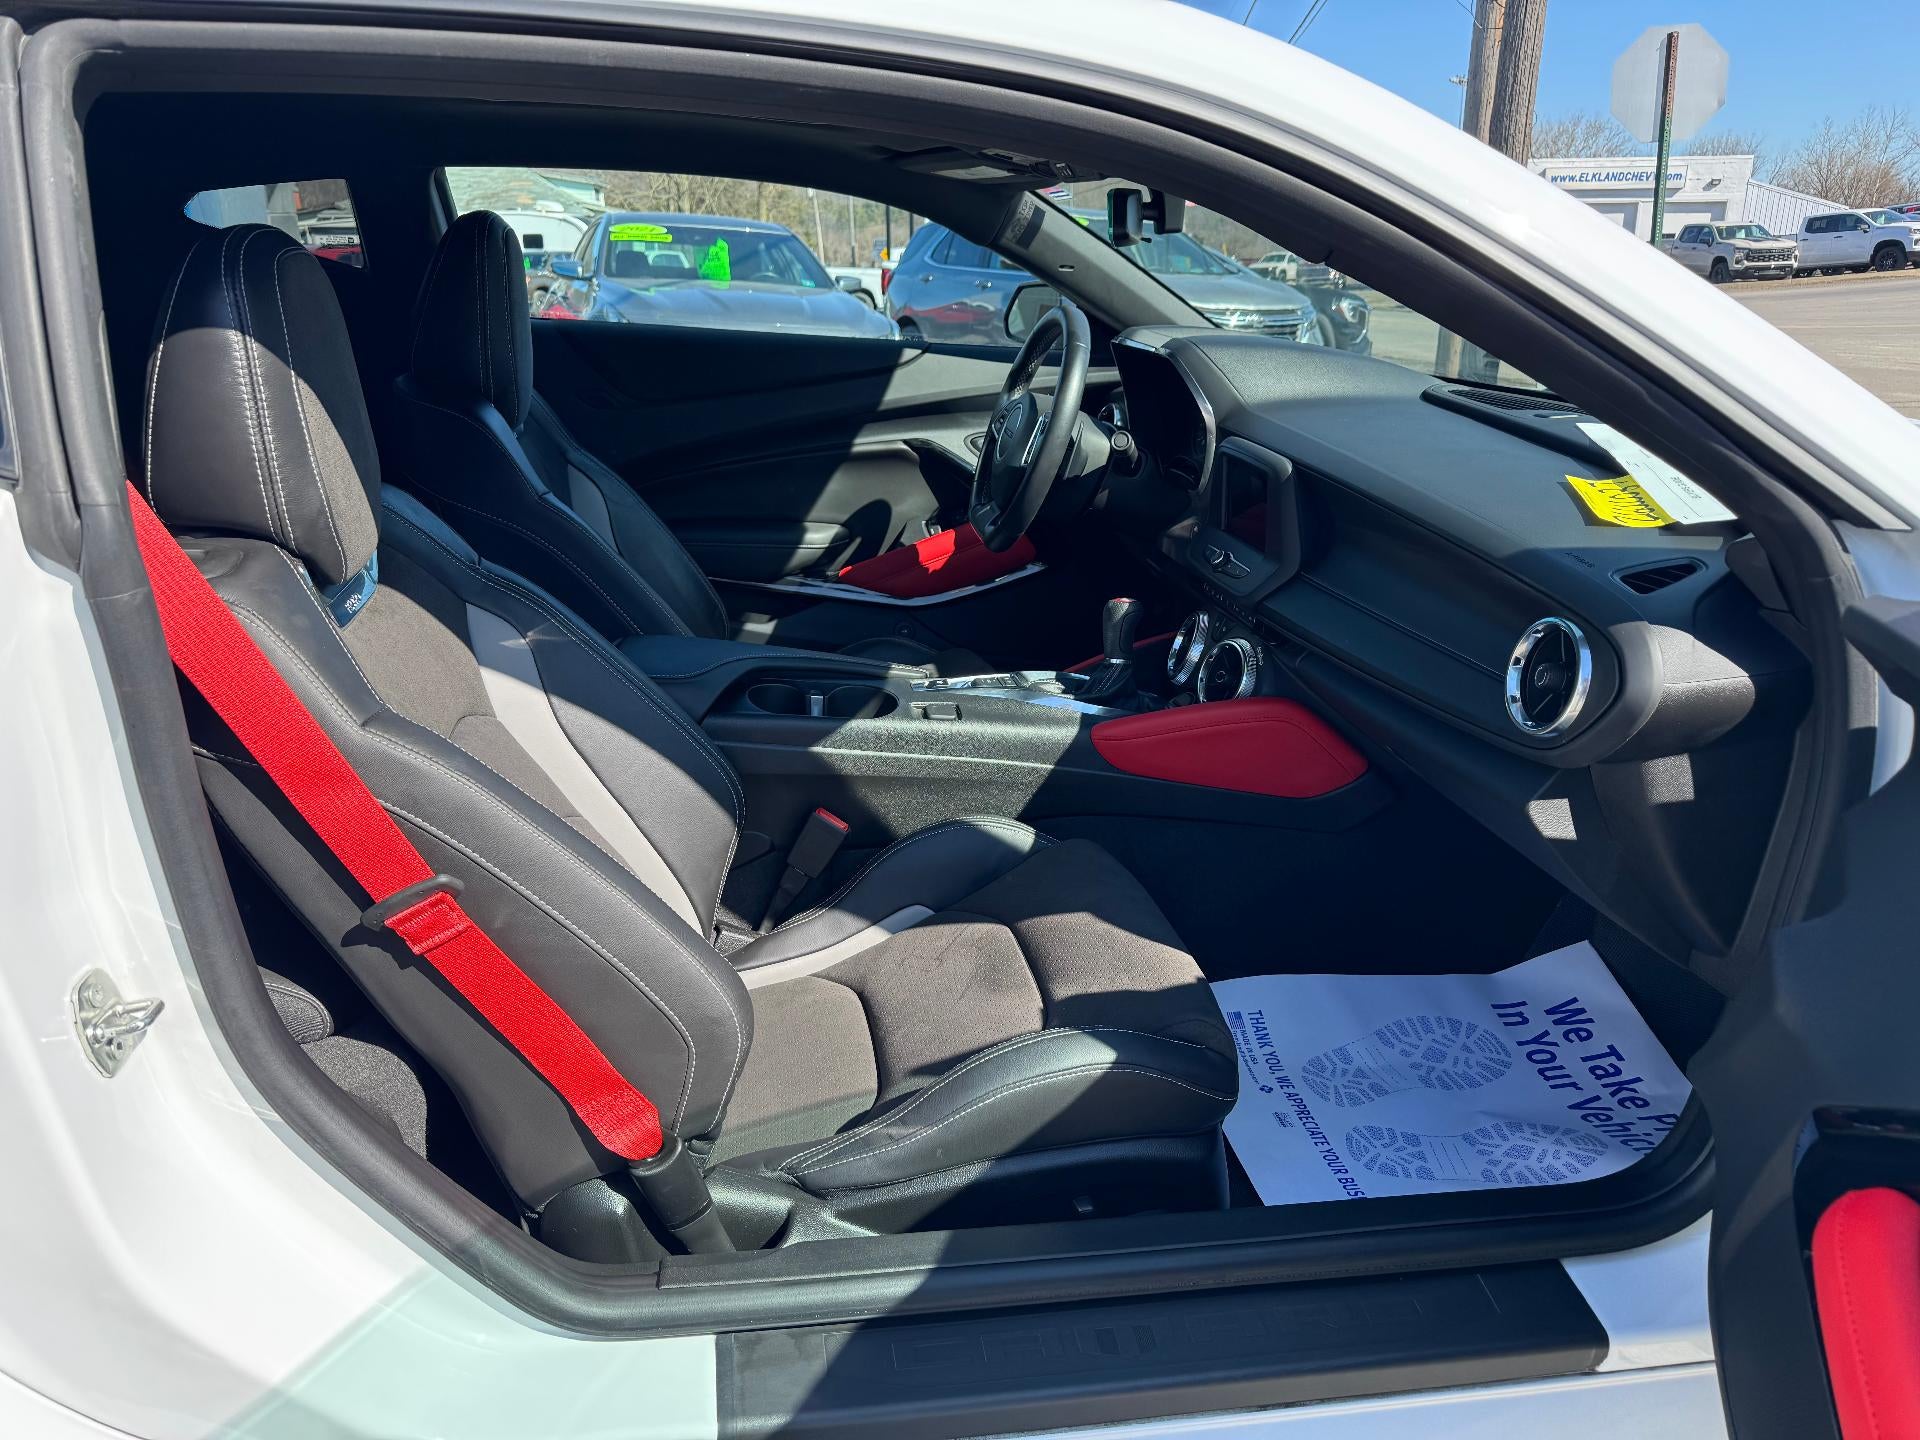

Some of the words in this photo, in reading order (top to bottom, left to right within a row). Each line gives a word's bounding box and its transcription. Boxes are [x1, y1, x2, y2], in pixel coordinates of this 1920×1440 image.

[1248, 1009, 1274, 1049] THANK
[1490, 1000, 1530, 1027] In
[1515, 1029, 1584, 1090] Your
[1262, 1050, 1285, 1075] YOU,
[1543, 996, 1595, 1044] We
[1579, 1044, 1650, 1109] Take
[1274, 1075, 1295, 1090] WE
[1283, 1091, 1330, 1147] APPRECIATE
[1319, 1148, 1349, 1175] YOUR
